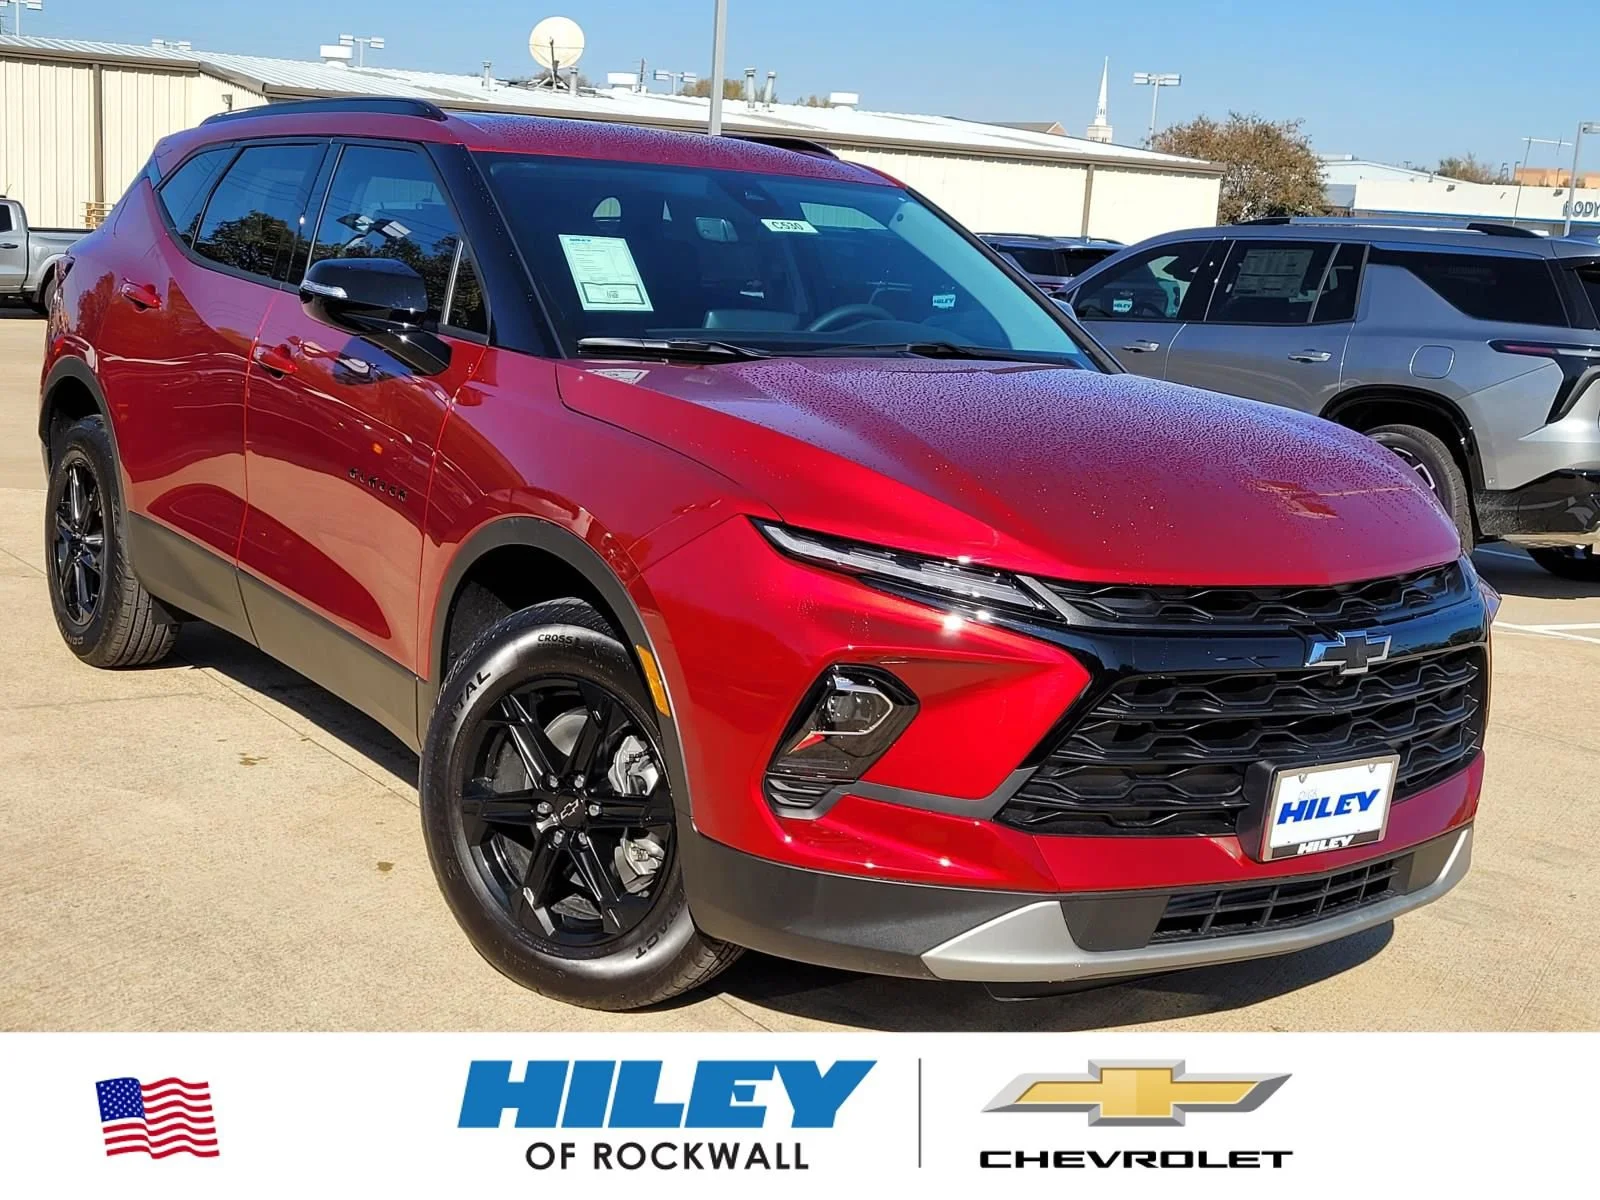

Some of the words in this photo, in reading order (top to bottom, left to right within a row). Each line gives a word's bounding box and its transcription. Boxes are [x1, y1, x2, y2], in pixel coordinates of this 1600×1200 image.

[771, 221, 804, 231] C530
[537, 633, 574, 644] CROSS
[1276, 788, 1381, 825] HILEY
[1296, 834, 1355, 855] HILEY
